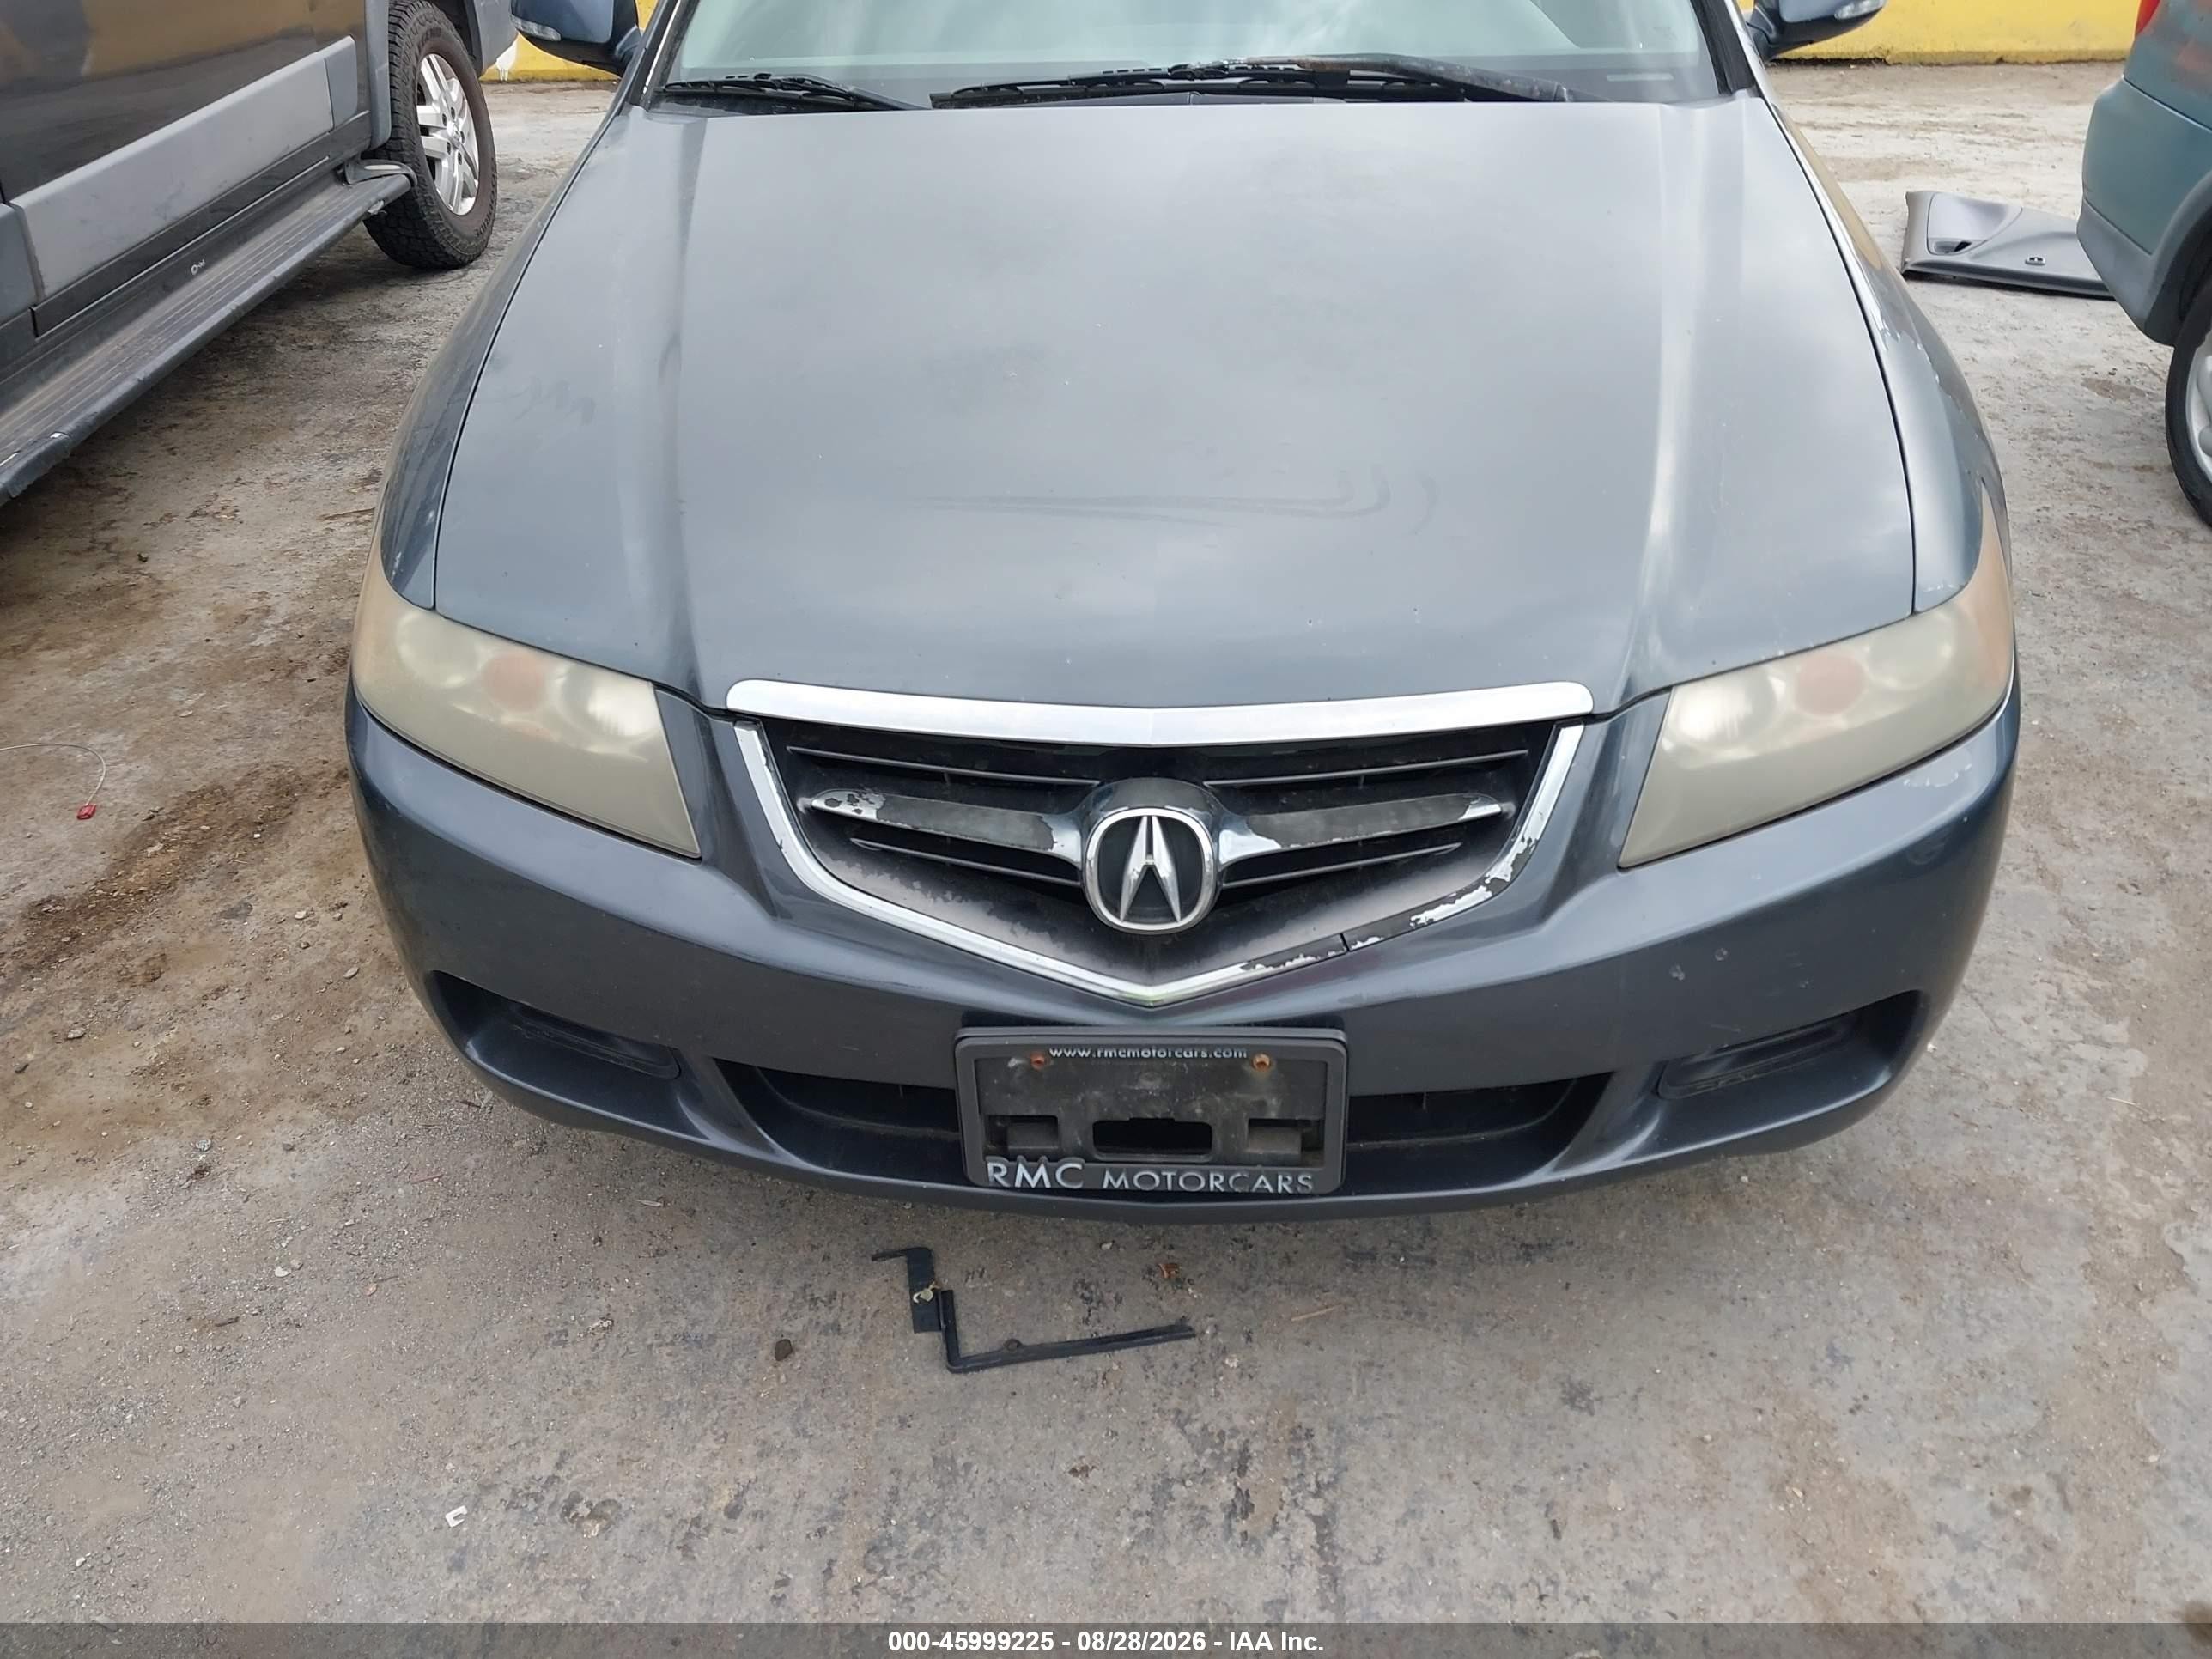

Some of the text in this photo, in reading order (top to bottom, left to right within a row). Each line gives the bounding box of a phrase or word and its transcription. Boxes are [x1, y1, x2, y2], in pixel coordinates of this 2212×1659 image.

[1048, 1046, 1248, 1060] www.rmcmotorcars.com
[987, 1160, 1313, 1193] RMC MOTORCARS
